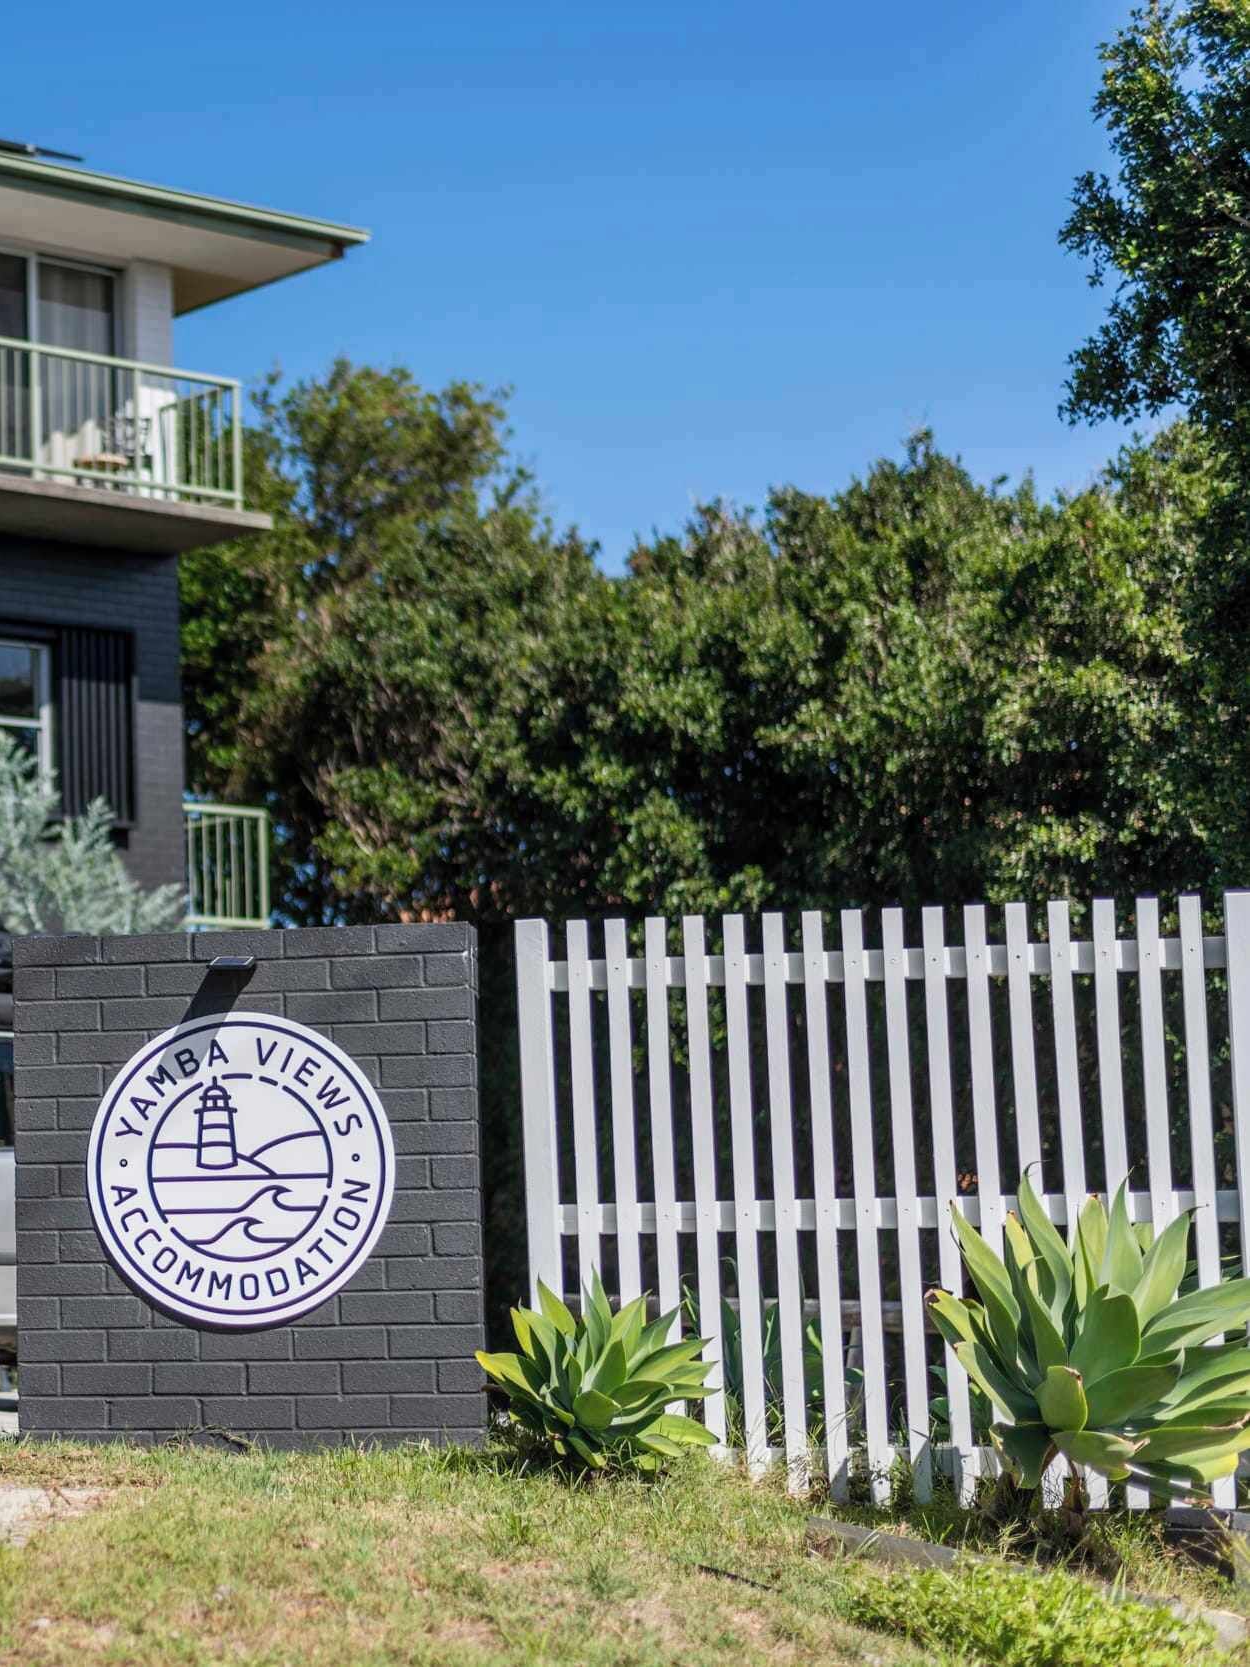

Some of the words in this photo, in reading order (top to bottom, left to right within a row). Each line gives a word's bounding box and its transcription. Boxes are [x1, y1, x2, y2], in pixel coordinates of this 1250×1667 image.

[114, 1038, 229, 1138] YAMBA
[255, 1037, 363, 1137] VIEWS
[110, 1178, 371, 1301] ACCOMMODATION
